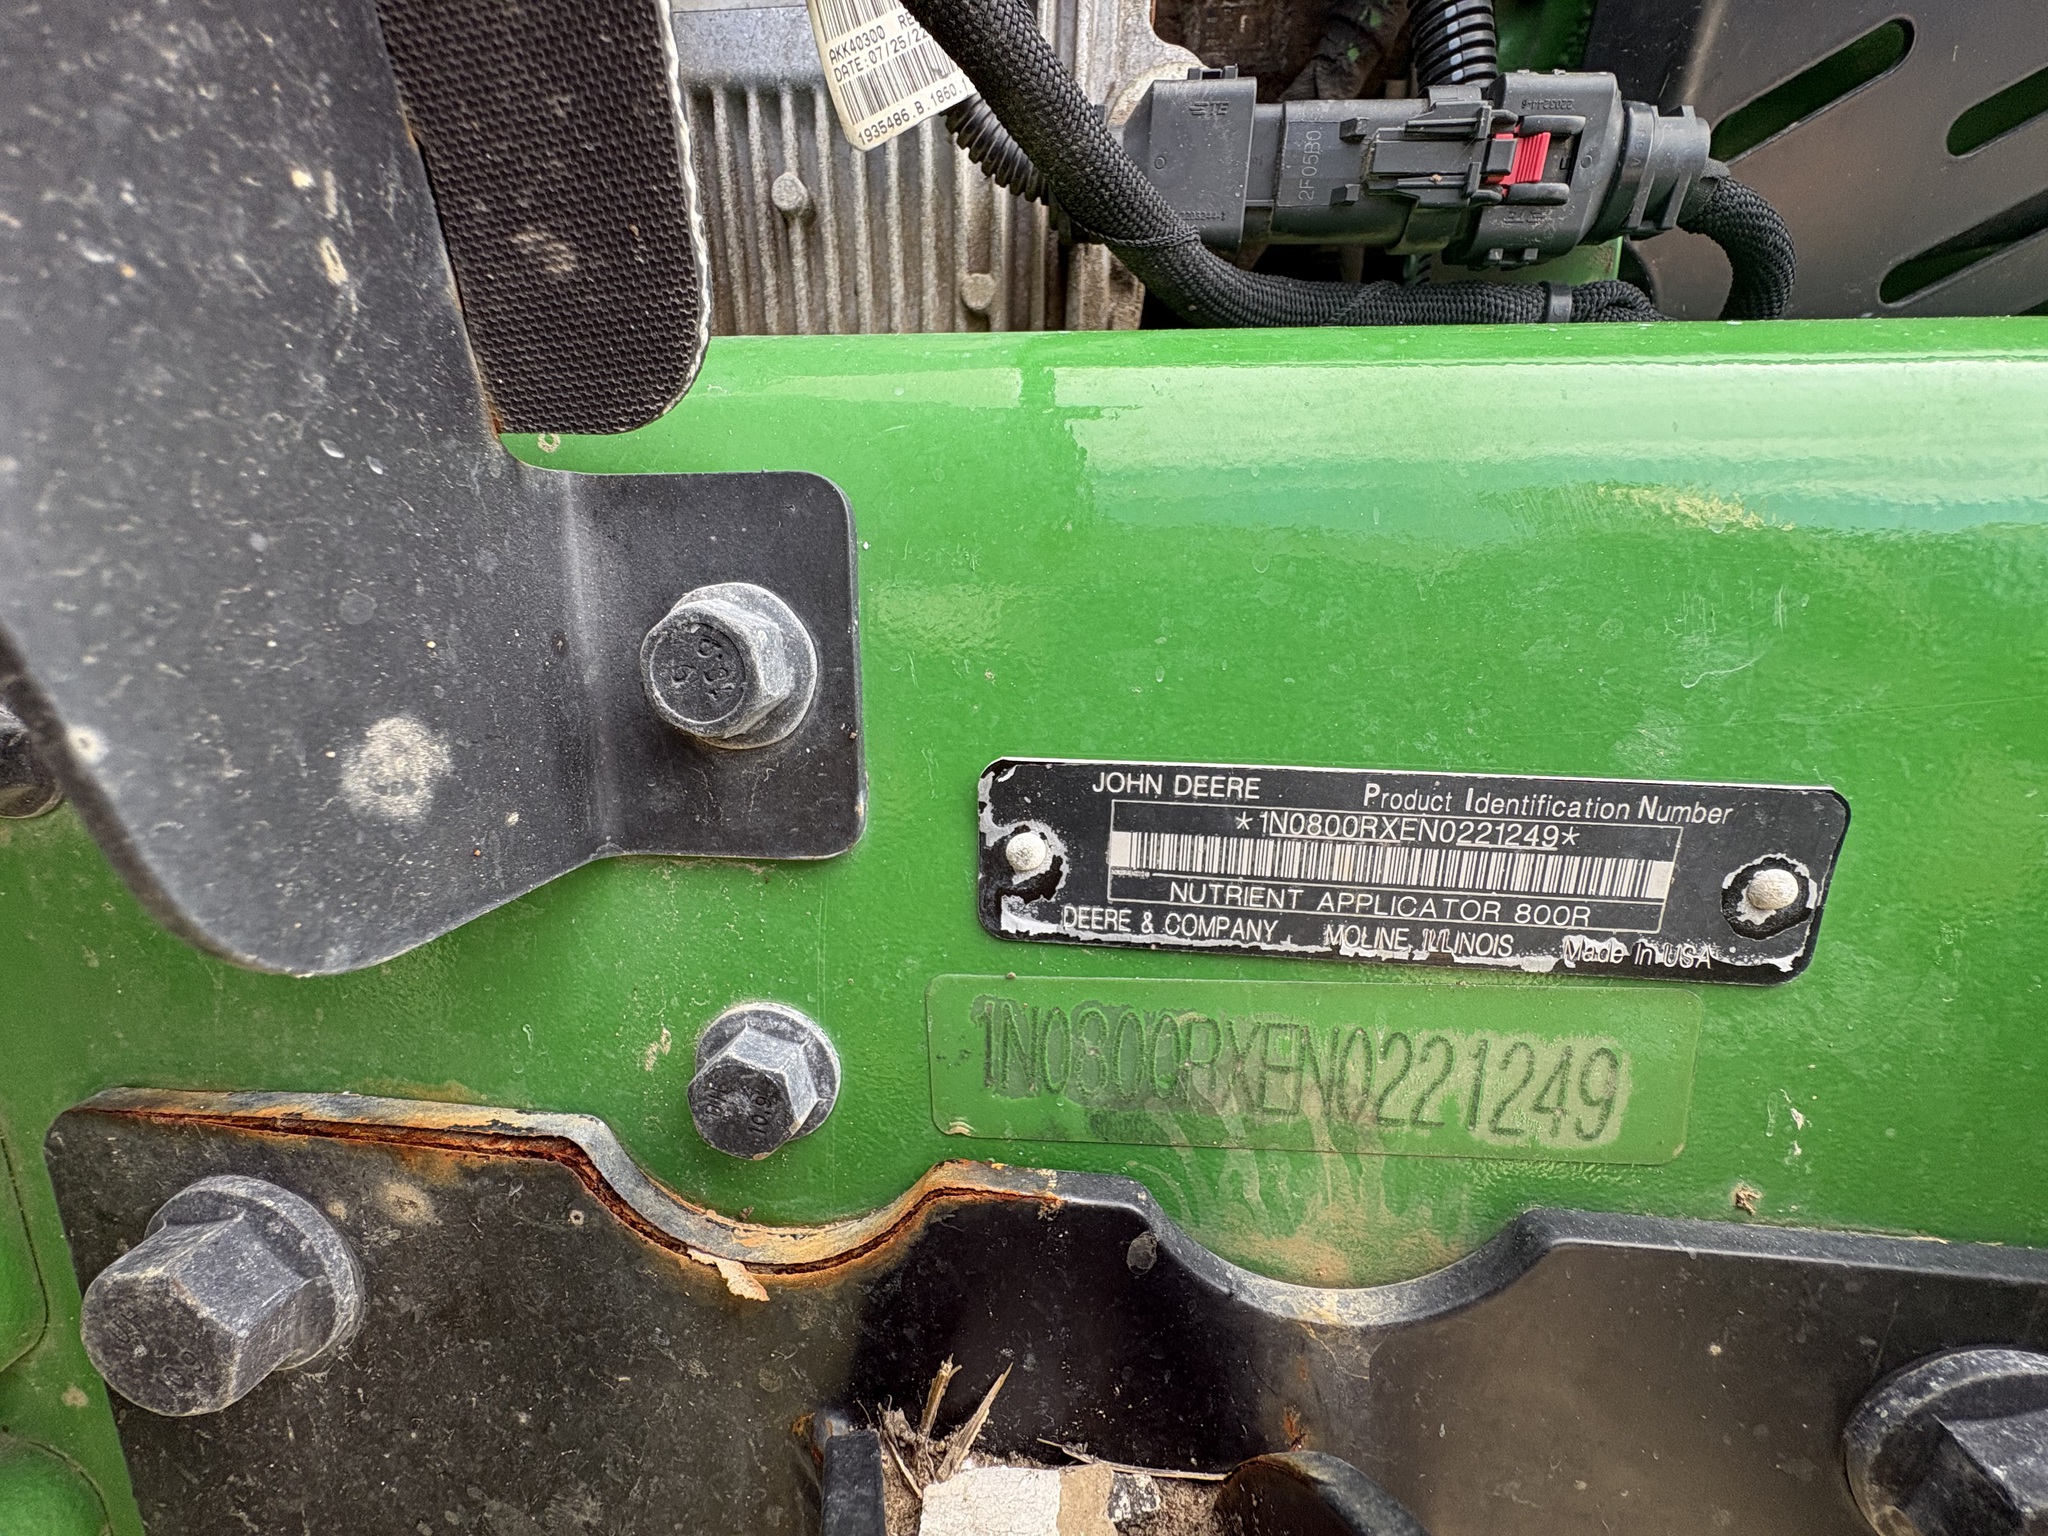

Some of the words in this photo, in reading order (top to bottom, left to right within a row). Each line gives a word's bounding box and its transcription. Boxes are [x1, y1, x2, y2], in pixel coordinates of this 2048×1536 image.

[897, 11, 917, 30] RE
[1298, 130, 1322, 200] 2F05B0
[1092, 771, 1162, 796] JOHN
[1174, 774, 1260, 800] DEERE
[1364, 783, 1451, 813] Product
[1465, 788, 1631, 821] Identification
[1639, 795, 1733, 826] Number
[1170, 881, 1304, 910] NUTRIENT
[1317, 885, 1501, 922] APPLICATOR
[1514, 903, 1591, 927] 800R
[1062, 905, 1131, 933] DEERE
[1140, 911, 1155, 934] &
[1165, 911, 1279, 942] COMPANY
[1422, 927, 1514, 957] ILLINOIS
[1563, 936, 1625, 964] Made
[1634, 942, 1654, 966] In
[1662, 942, 1712, 969] USA
